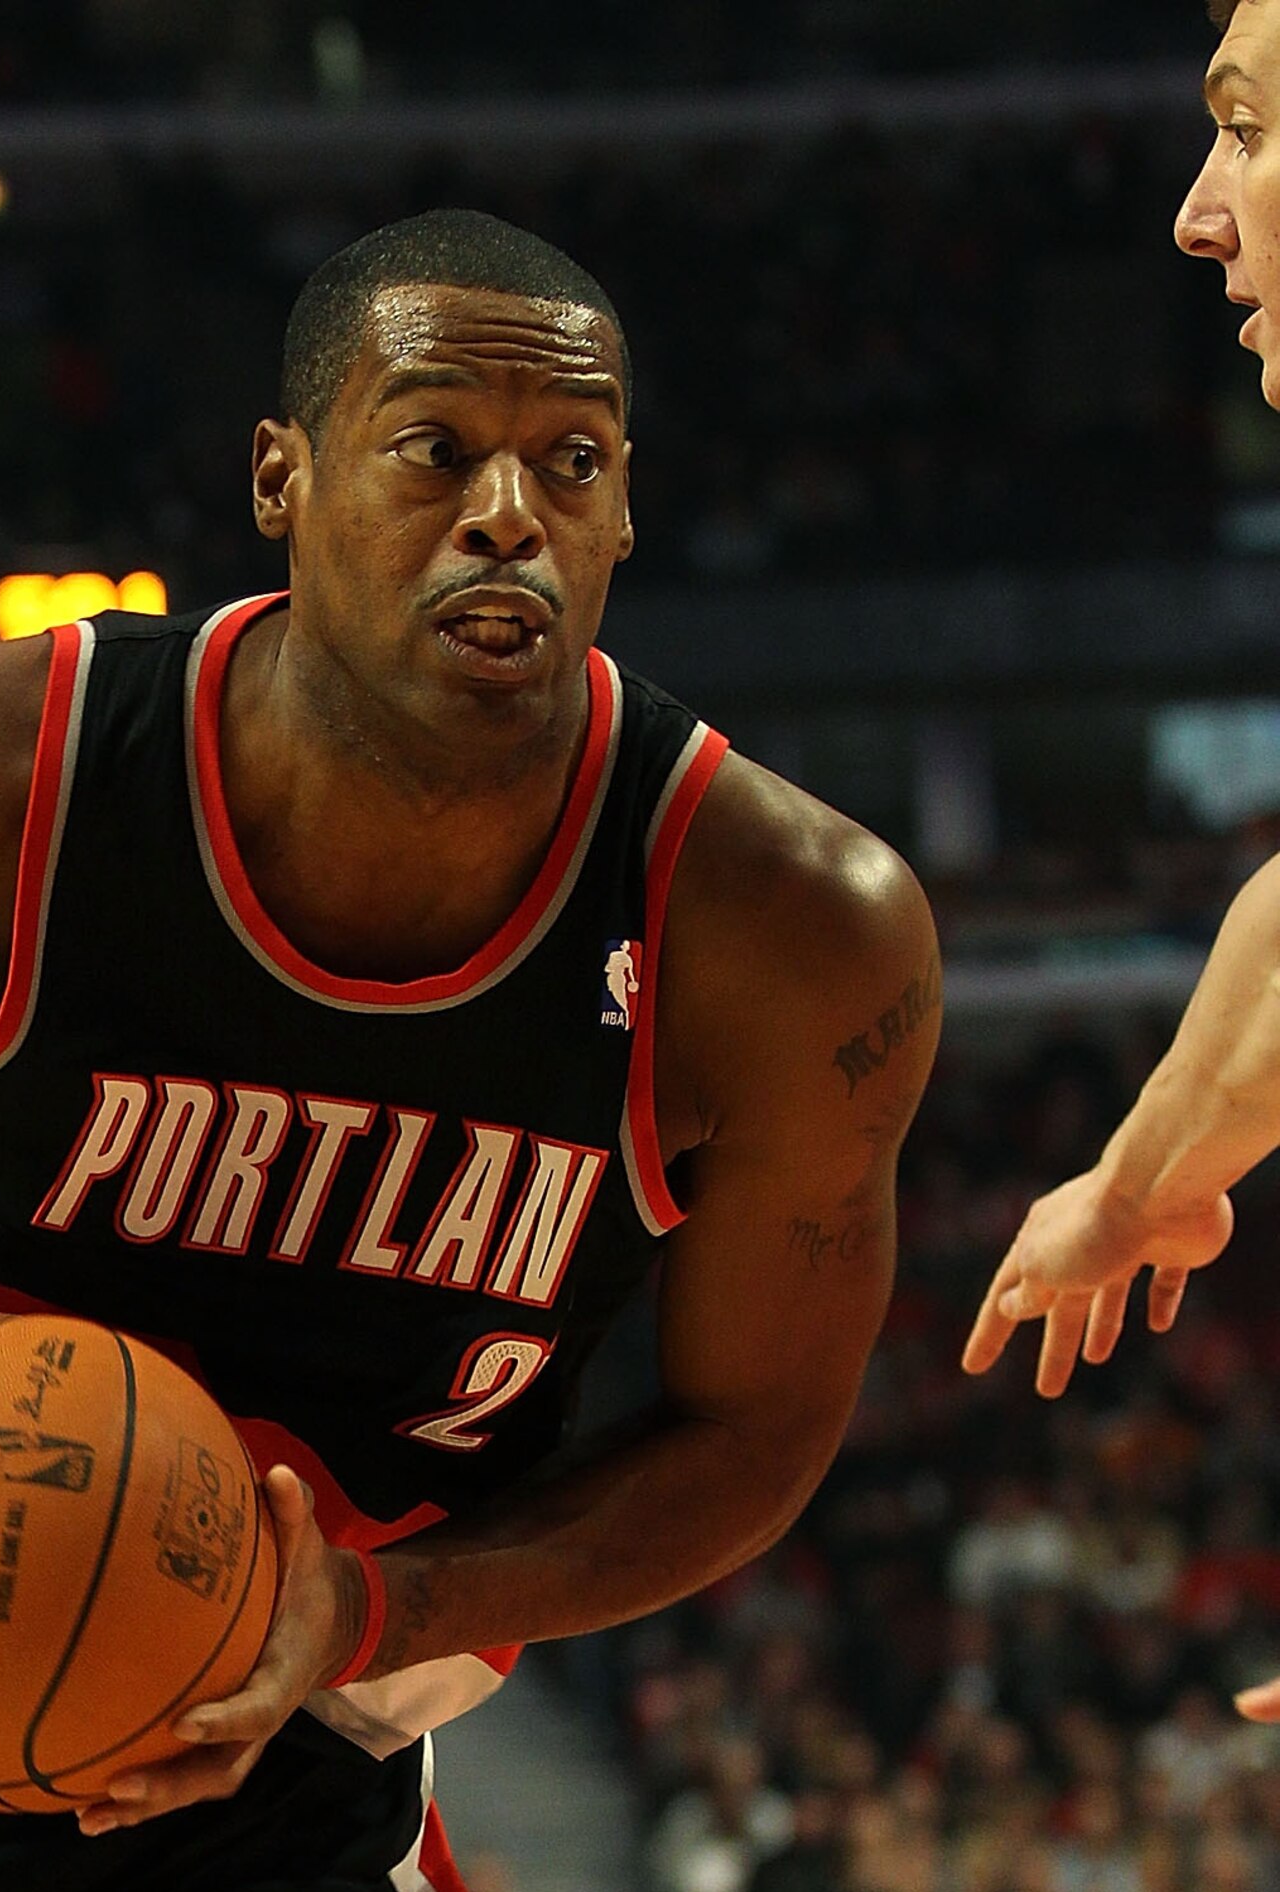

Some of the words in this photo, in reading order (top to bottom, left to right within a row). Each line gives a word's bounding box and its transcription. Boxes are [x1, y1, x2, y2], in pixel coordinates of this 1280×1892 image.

[600, 1010, 625, 1027] NBA
[31, 1072, 610, 1308] PORTLAN
[392, 1330, 560, 1453] 2
